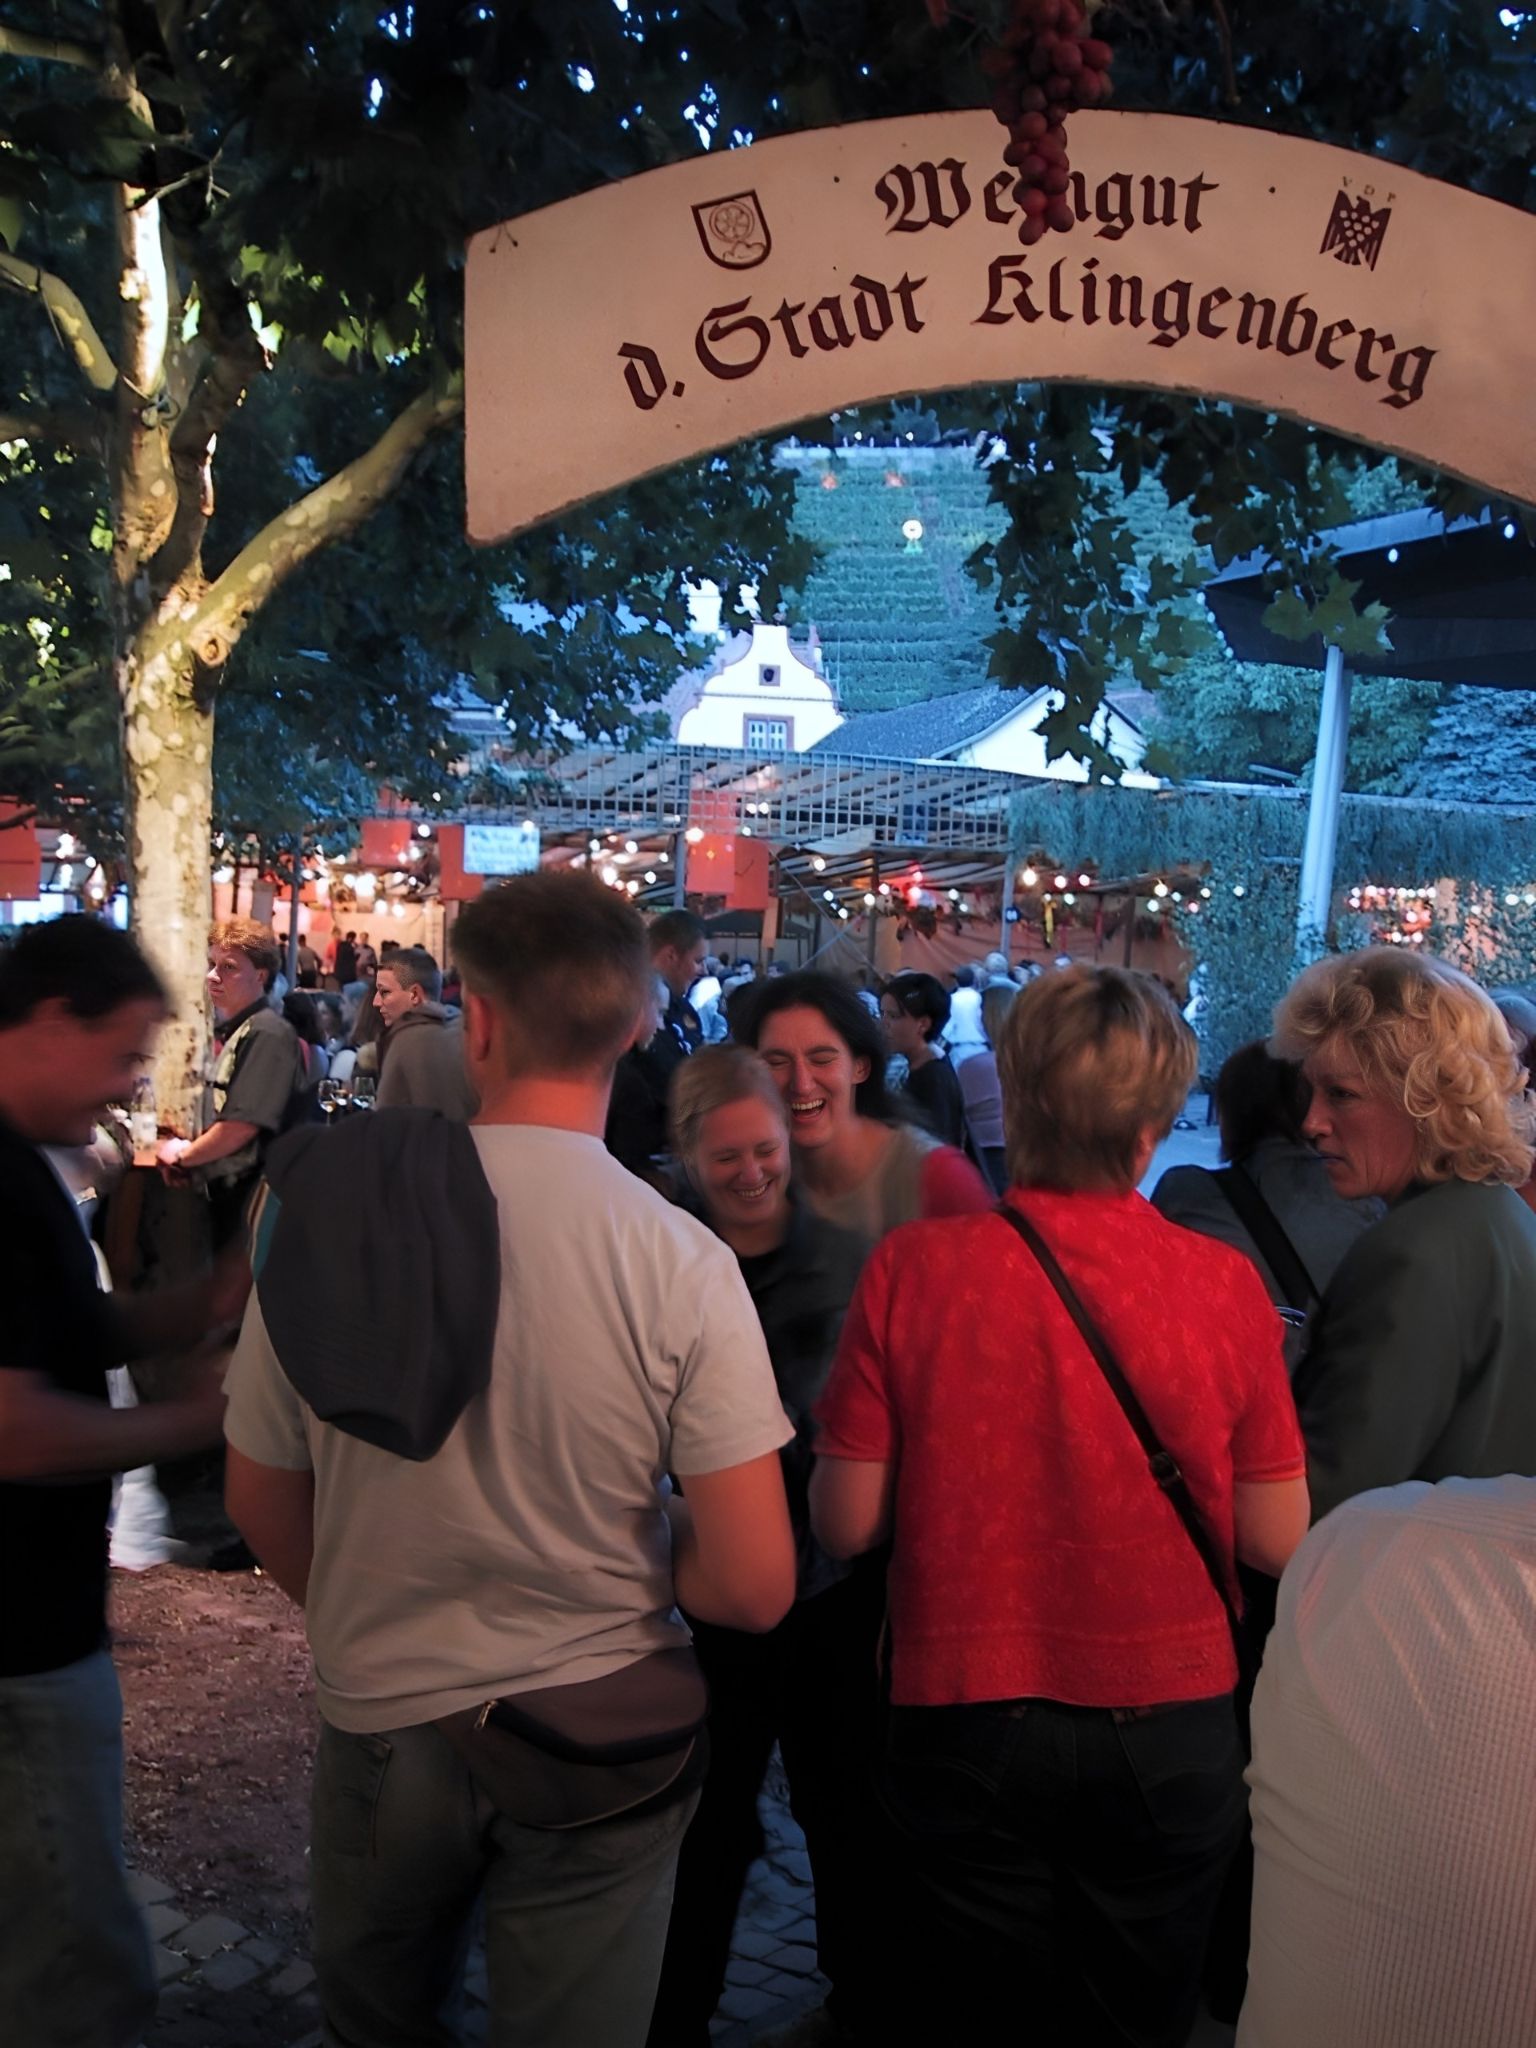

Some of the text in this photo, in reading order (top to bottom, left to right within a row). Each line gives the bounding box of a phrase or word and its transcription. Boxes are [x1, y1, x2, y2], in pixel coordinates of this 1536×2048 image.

[874, 157, 1220, 241] Wengut
[616, 253, 1438, 411] d. Stadt Klingenberg
